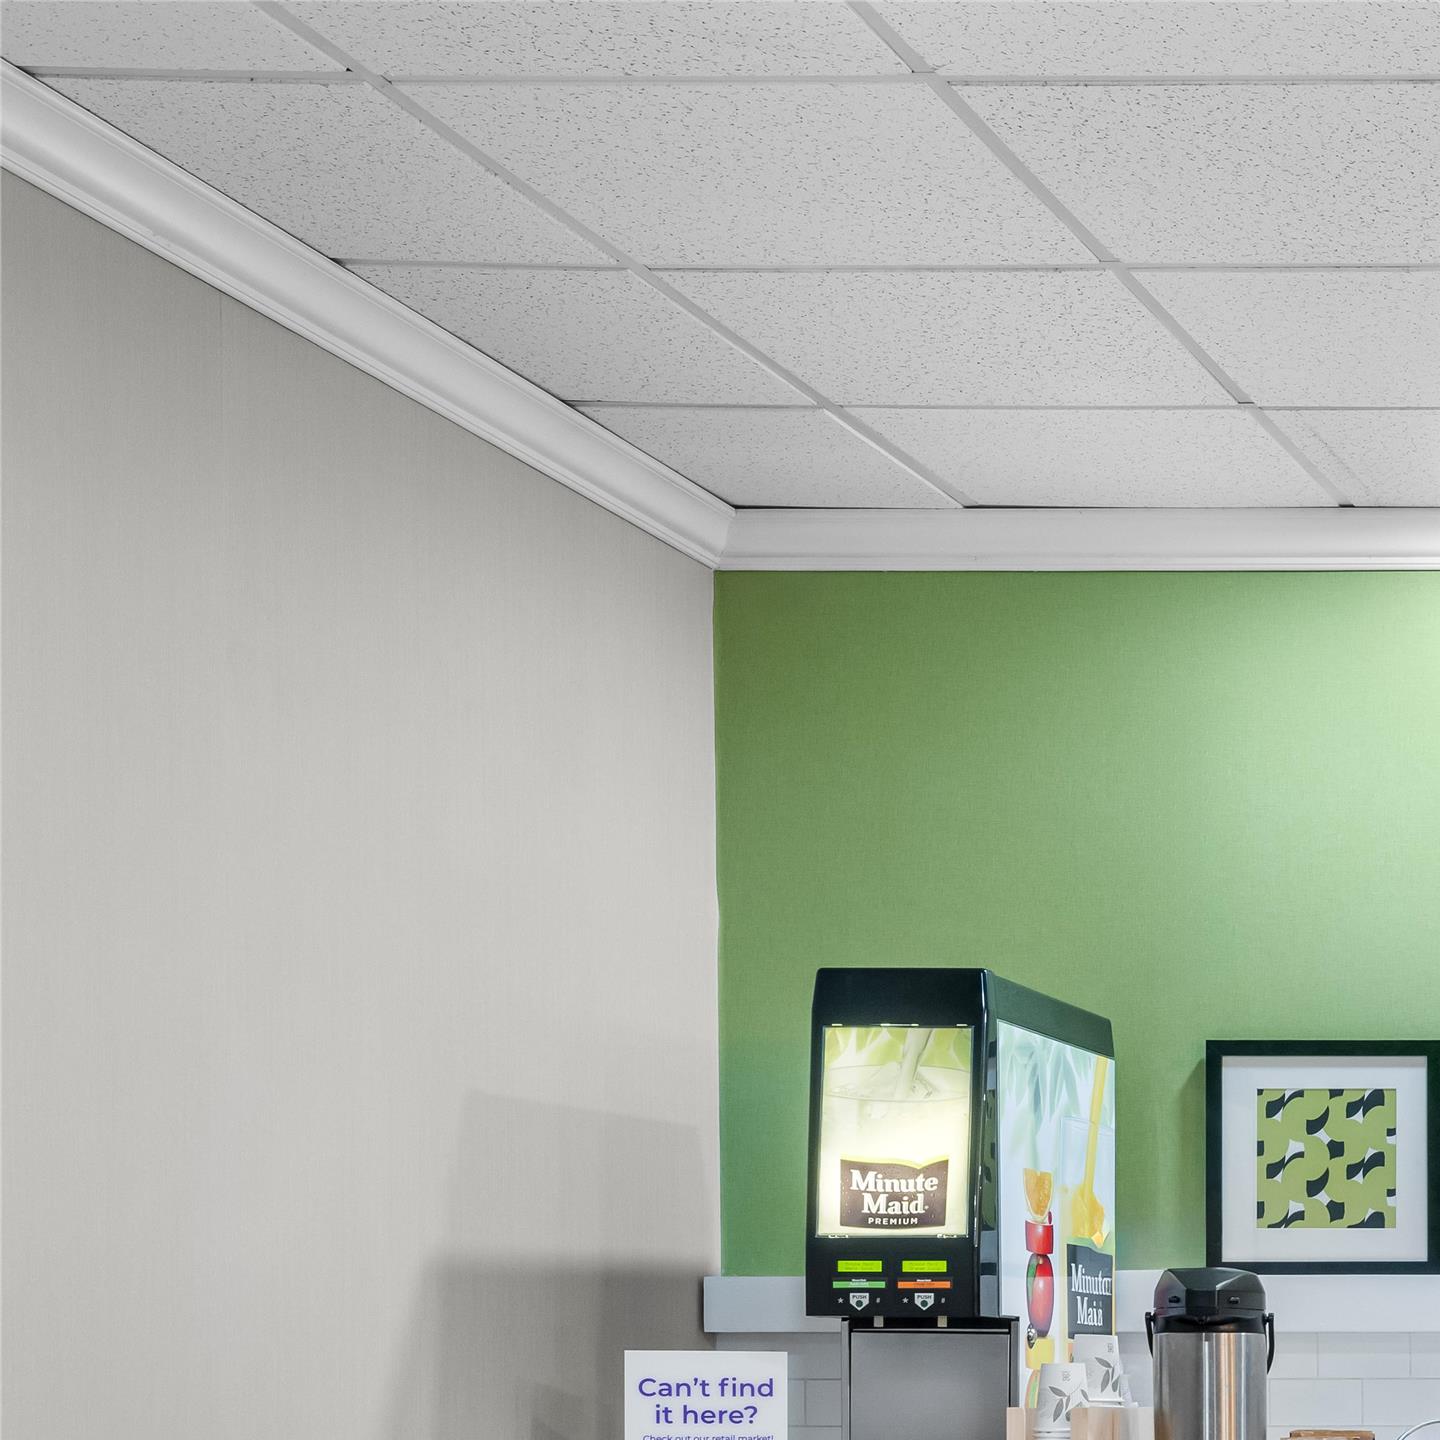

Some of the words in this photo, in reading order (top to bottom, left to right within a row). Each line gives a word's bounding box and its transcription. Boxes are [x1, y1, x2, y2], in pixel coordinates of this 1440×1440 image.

[849, 1168, 939, 1193] Minute
[861, 1192, 926, 1215] Maid
[867, 1217, 919, 1226] PREMIUM
[638, 1377, 711, 1397] Can't
[718, 1377, 774, 1397] find
[655, 1403, 674, 1424] it
[683, 1404, 758, 1424] here?
